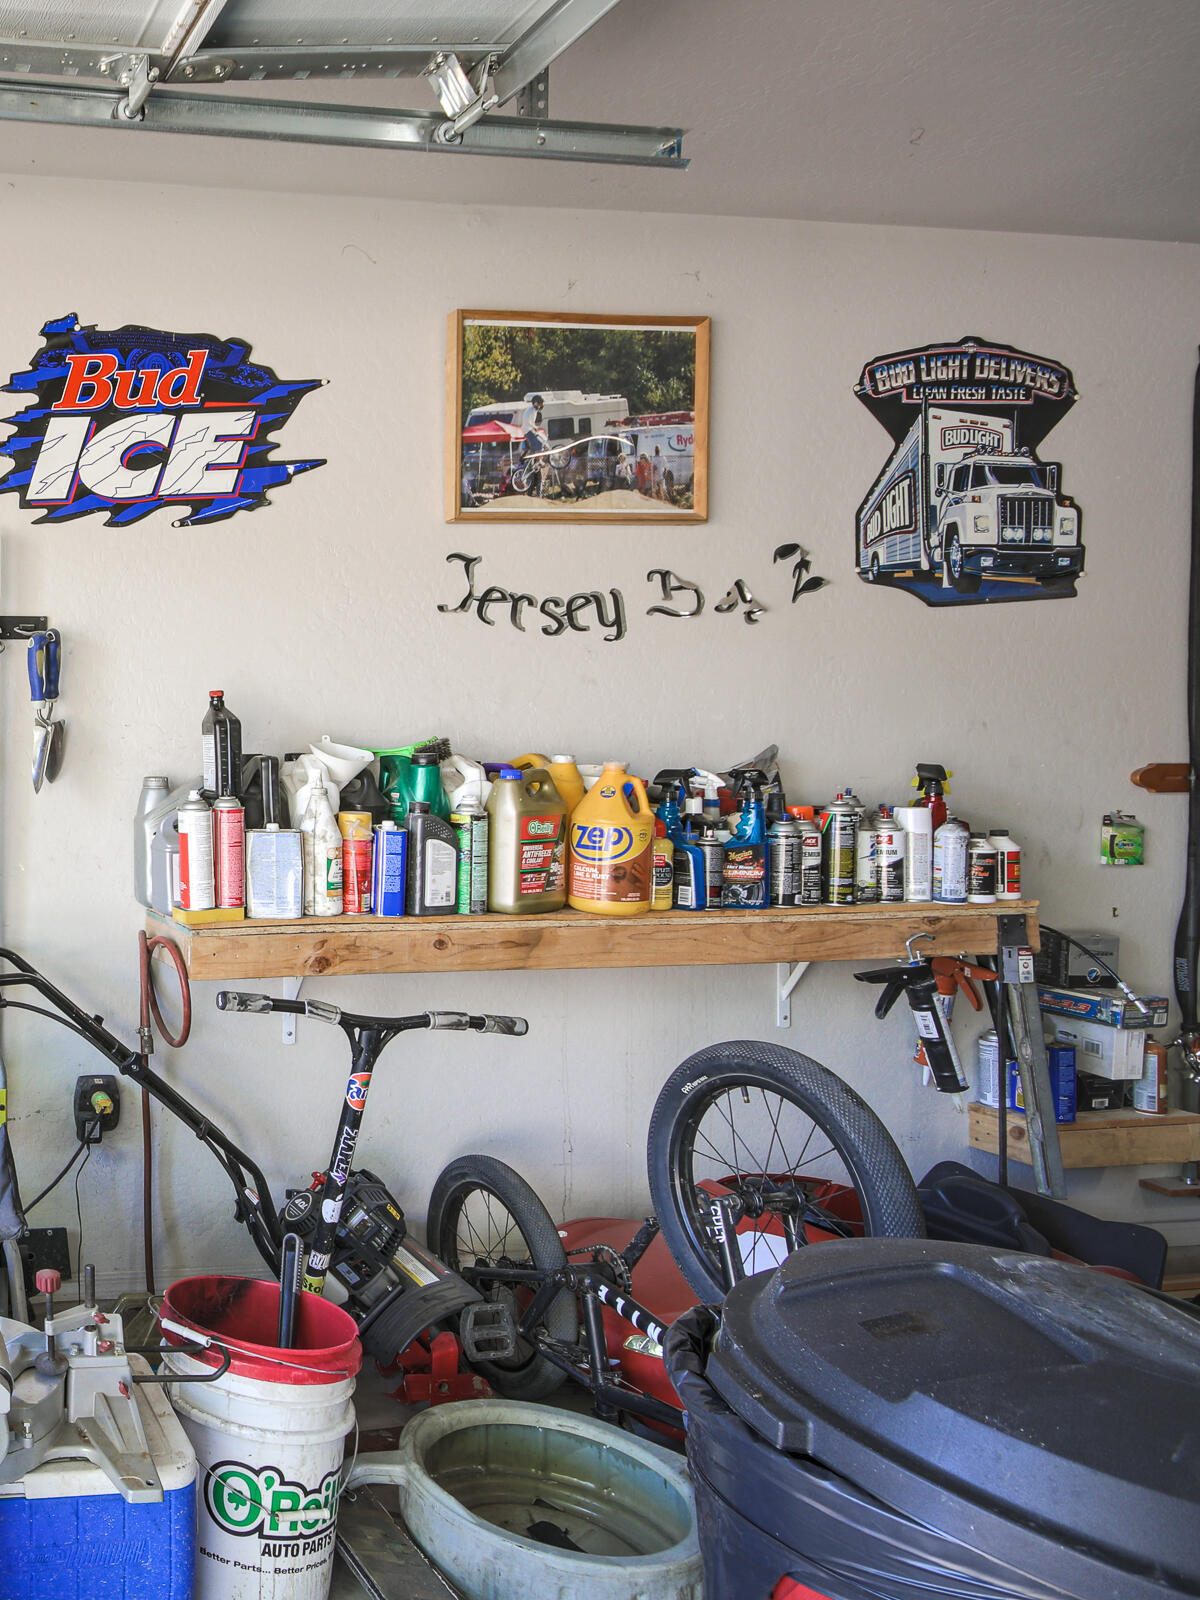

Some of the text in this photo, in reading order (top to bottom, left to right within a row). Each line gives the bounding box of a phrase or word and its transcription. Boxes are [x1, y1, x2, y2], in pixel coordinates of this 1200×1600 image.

[52, 350, 208, 411] Bud
[872, 352, 1061, 393] BUD LIGHT DELIVERS
[912, 384, 1027, 400] CLEAN FRESH TASTE
[25, 411, 257, 501] ICE
[882, 478, 910, 535] LIGHT
[437, 552, 628, 642] Jersey
[200, 1547, 231, 1565] Better
[261, 1533, 332, 1558] AUTO PARTS
